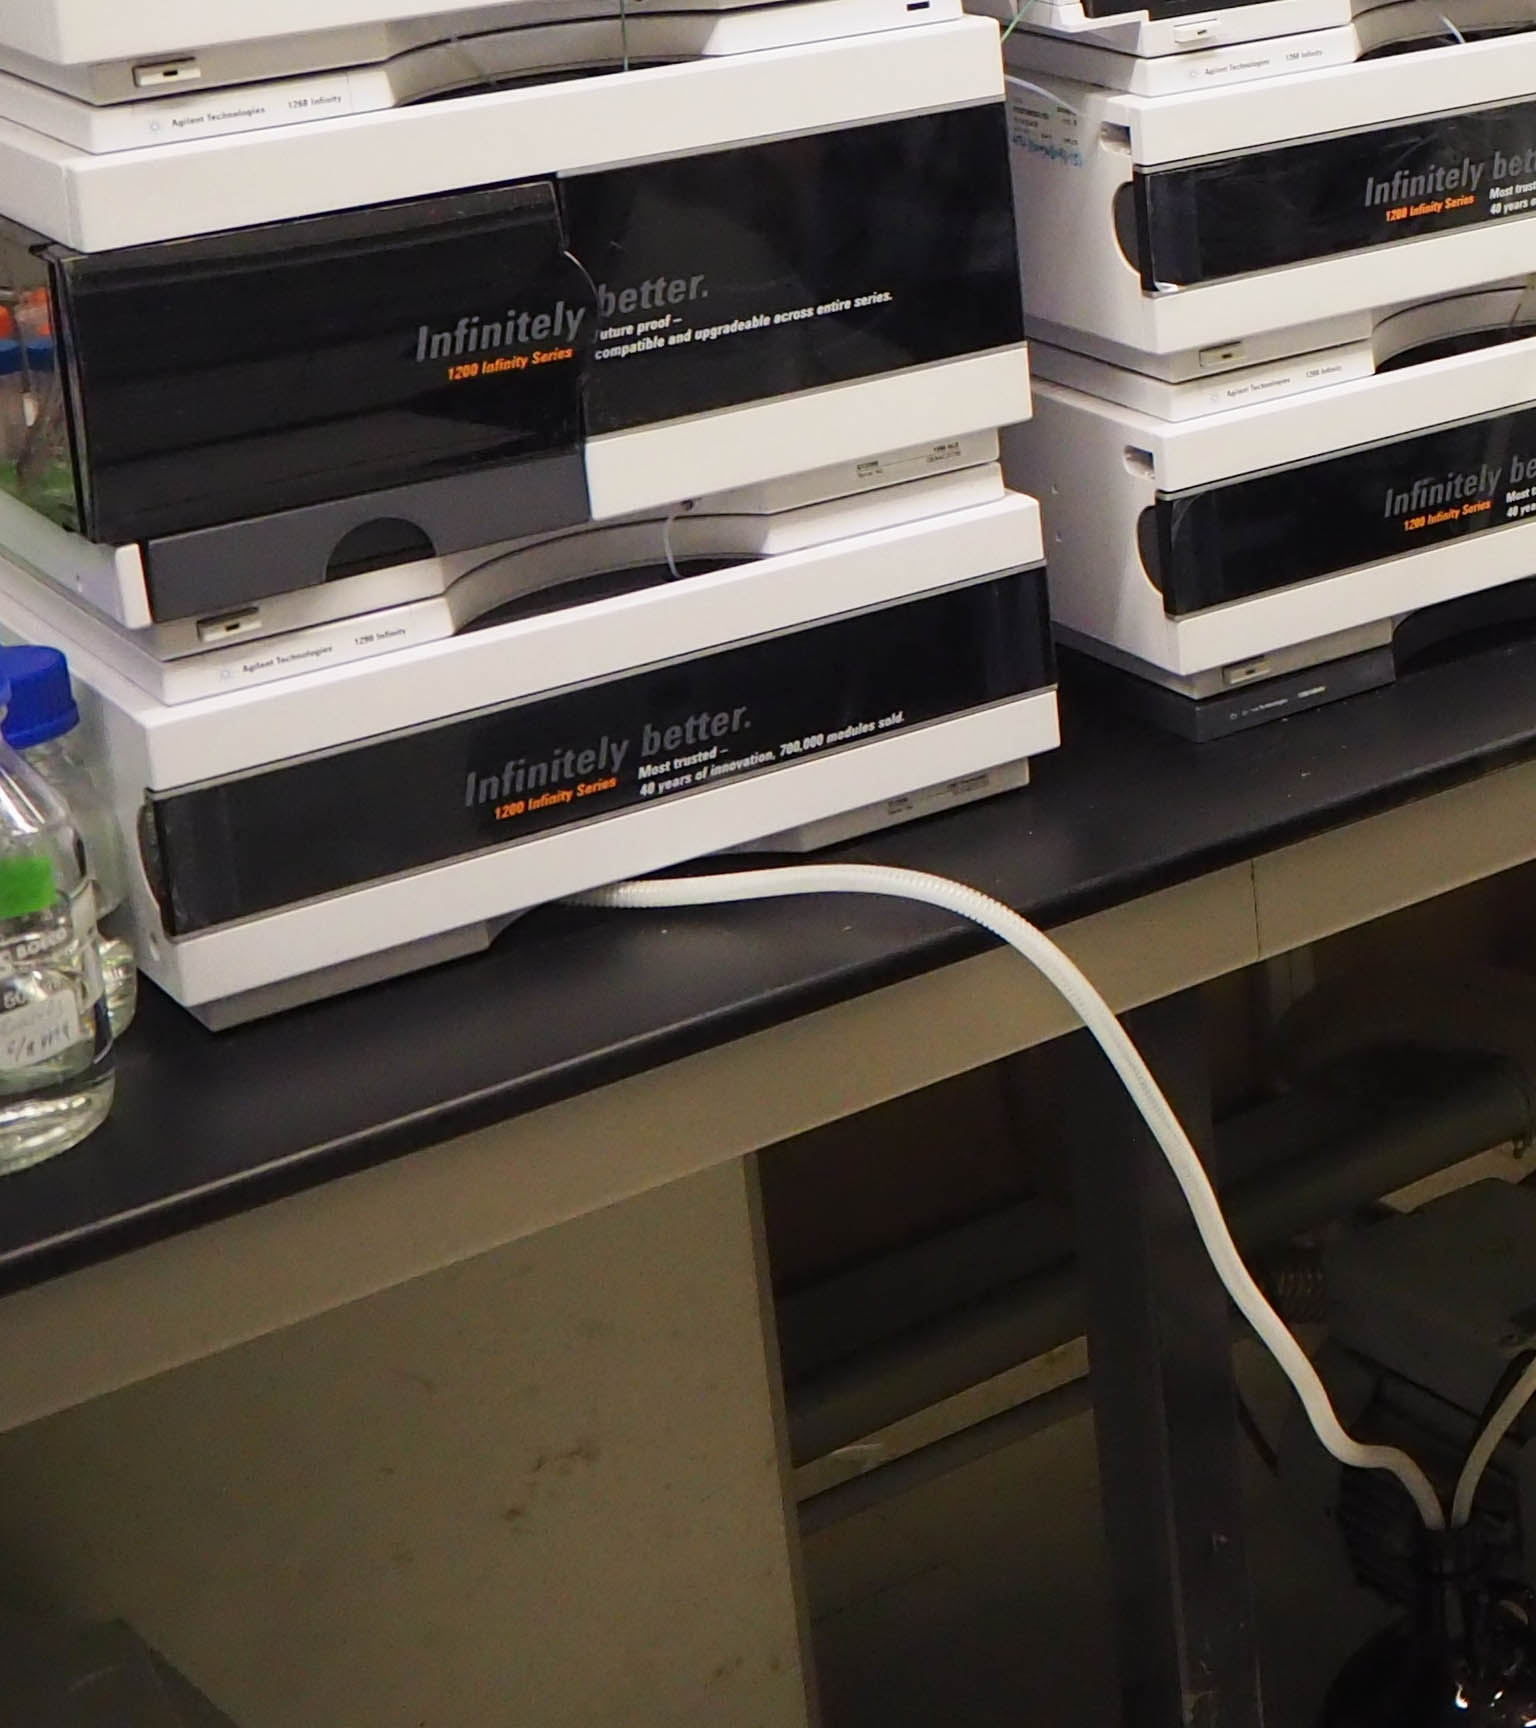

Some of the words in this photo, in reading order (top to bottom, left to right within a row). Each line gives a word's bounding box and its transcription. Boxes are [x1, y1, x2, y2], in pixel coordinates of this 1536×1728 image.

[172, 114, 205, 127] Agilent
[207, 107, 265, 121] Technologies
[1364, 156, 1485, 208] Infinitely
[1489, 184, 1514, 200] Most
[1409, 200, 1444, 218] Infinity
[1445, 194, 1475, 210] Series
[1503, 197, 1530, 215] years
[415, 301, 586, 363] Infinitely
[599, 273, 709, 318] better.
[595, 335, 666, 362] compatible
[668, 328, 692, 347] and
[694, 314, 772, 342] upgradeable
[773, 307, 814, 325] across
[816, 298, 851, 315] entire
[853, 290, 893, 308] series.
[595, 324, 633, 341] uture
[636, 315, 672, 338] proof
[447, 362, 479, 381] 1200
[481, 354, 529, 376] Infinity
[531, 347, 574, 364] Series
[1384, 463, 1502, 519] Infinitely
[1505, 489, 1530, 503] Most
[1427, 508, 1461, 526] Infinity
[1462, 500, 1492, 516] Series
[276, 646, 333, 665] Technologies
[464, 735, 628, 807] Infinitely
[641, 705, 752, 758] better.
[637, 762, 671, 780] Most
[673, 747, 718, 770] trusted
[639, 779, 656, 798] 40
[657, 772, 692, 796] years
[695, 768, 708, 783] of
[709, 750, 777, 778] innovation,
[826, 722, 876, 745] modules
[494, 800, 526, 821] 1200
[528, 789, 574, 811] Infinity
[576, 777, 617, 798] Series
